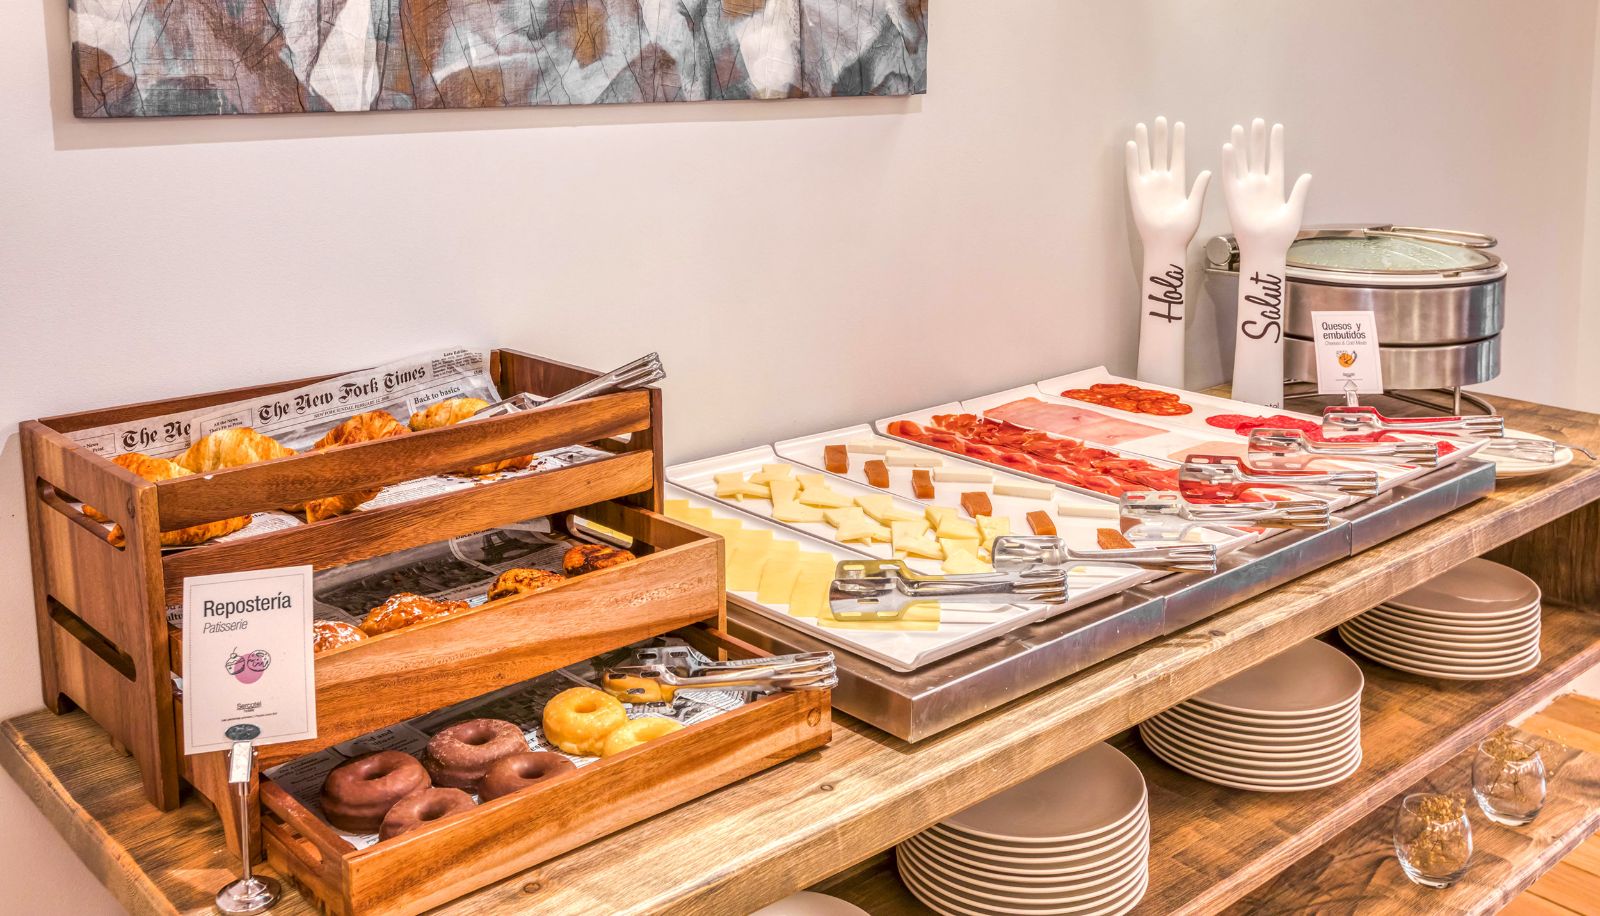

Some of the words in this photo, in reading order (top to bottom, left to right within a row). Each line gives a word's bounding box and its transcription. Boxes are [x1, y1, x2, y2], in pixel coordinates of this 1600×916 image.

[1148, 264, 1185, 323] Hola
[1241, 271, 1282, 344] Salut
[1321, 322, 1352, 331] Quesos
[1356, 323, 1361, 332] y
[1323, 331, 1366, 340] embutidos
[258, 404, 290, 425] The
[294, 392, 334, 415] New
[384, 365, 426, 392] Times
[413, 394, 431, 405] Back
[431, 392, 439, 400] to
[439, 386, 461, 397] basics
[121, 430, 158, 451] The
[163, 420, 191, 443] Ne
[203, 591, 292, 619] Repostería
[202, 618, 249, 634] Patisserie
